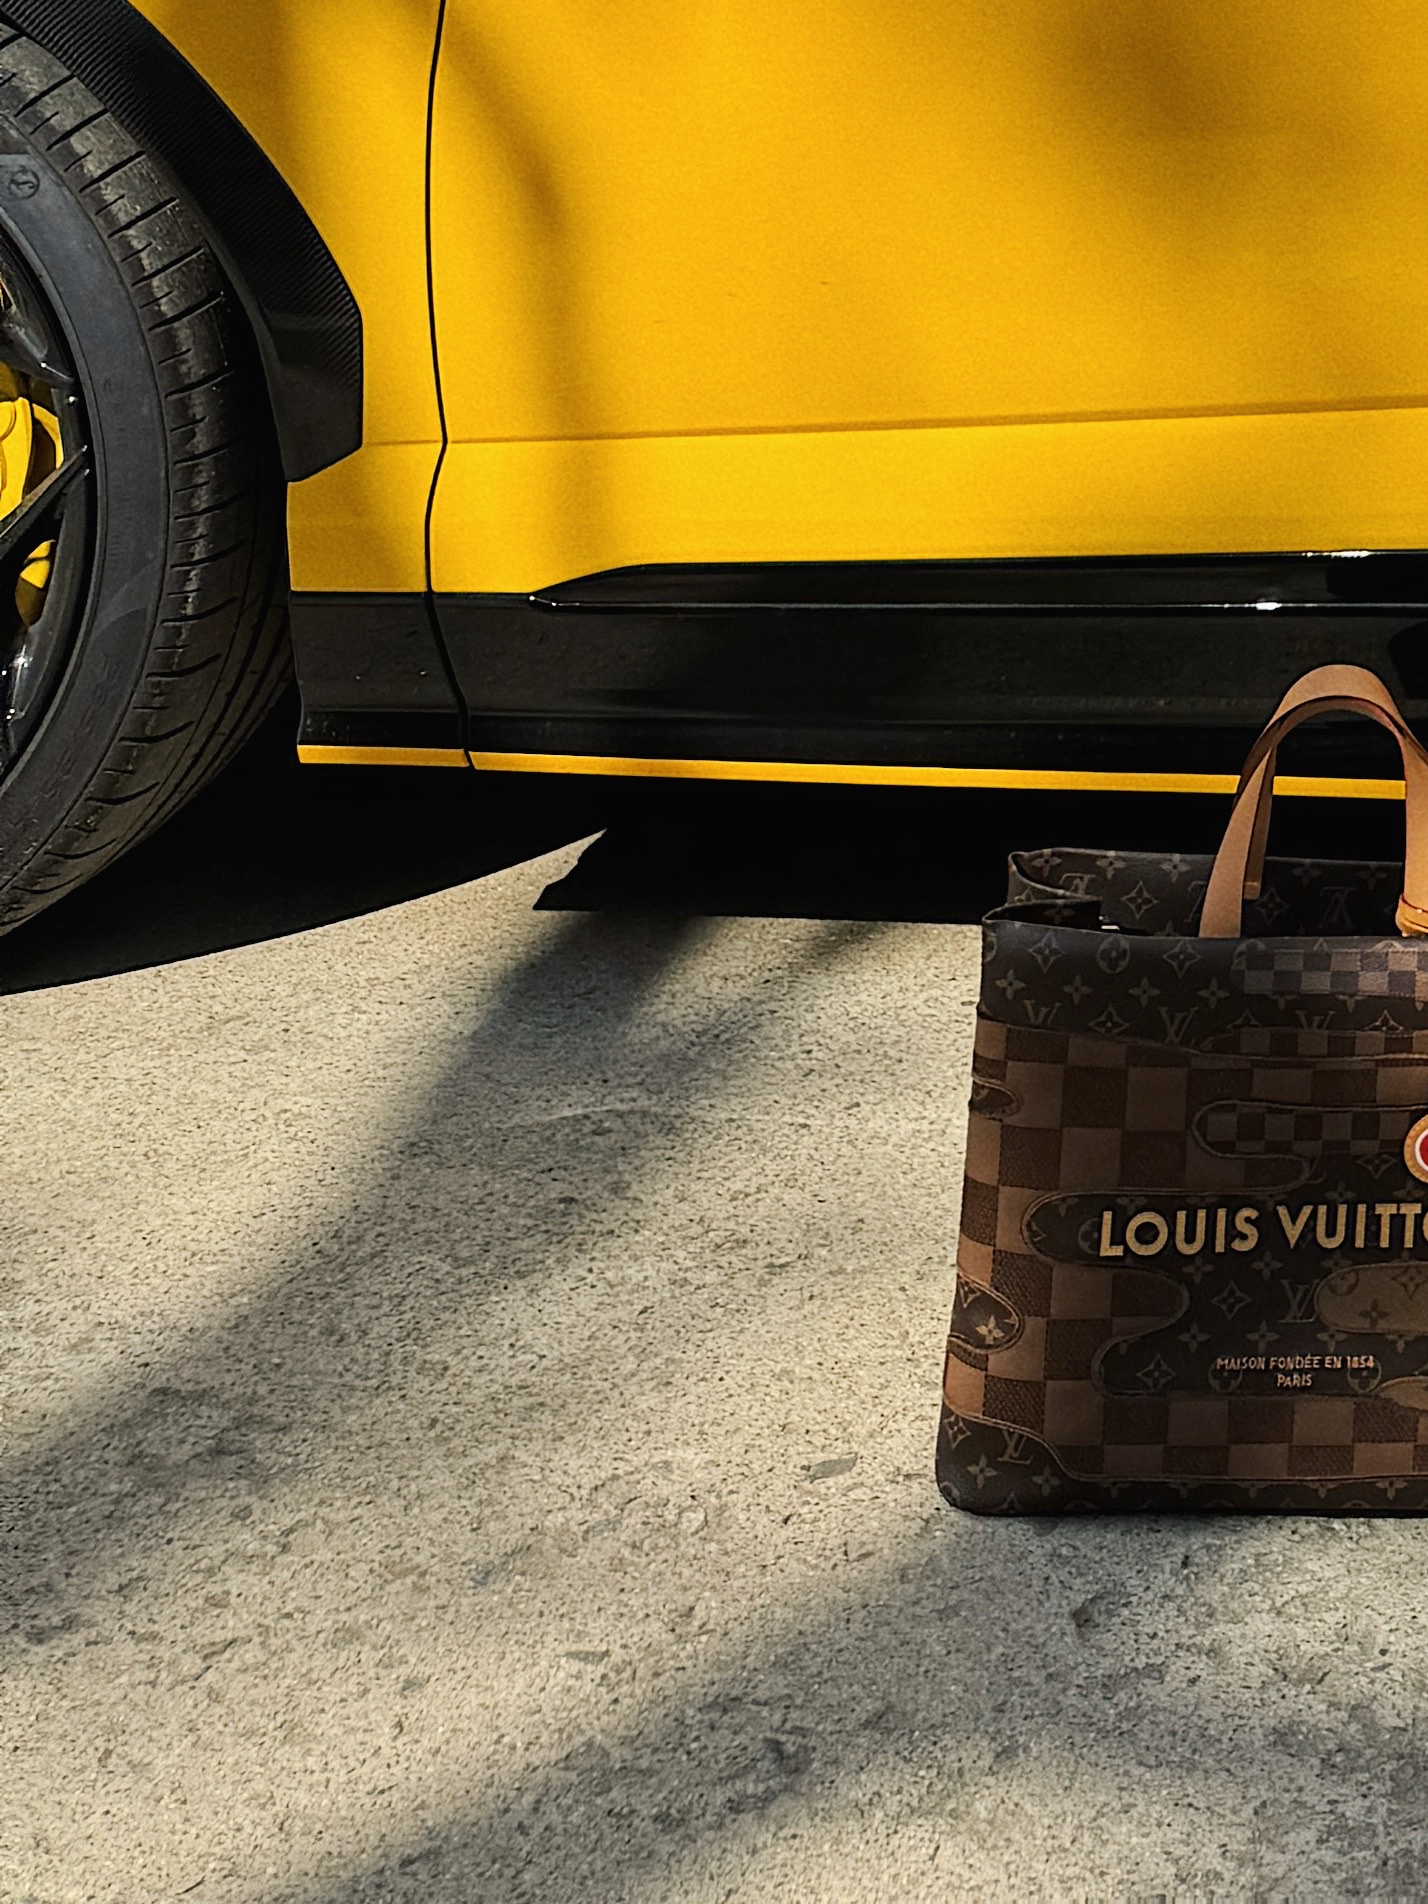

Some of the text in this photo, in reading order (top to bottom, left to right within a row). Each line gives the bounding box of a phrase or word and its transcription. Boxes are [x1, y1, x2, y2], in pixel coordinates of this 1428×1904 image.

[1099, 1205, 1260, 1257] LOUIS
[1215, 1352, 1375, 1371] MAISON FONDÉE EN 1854
[1276, 1373, 1313, 1388] PARIS
